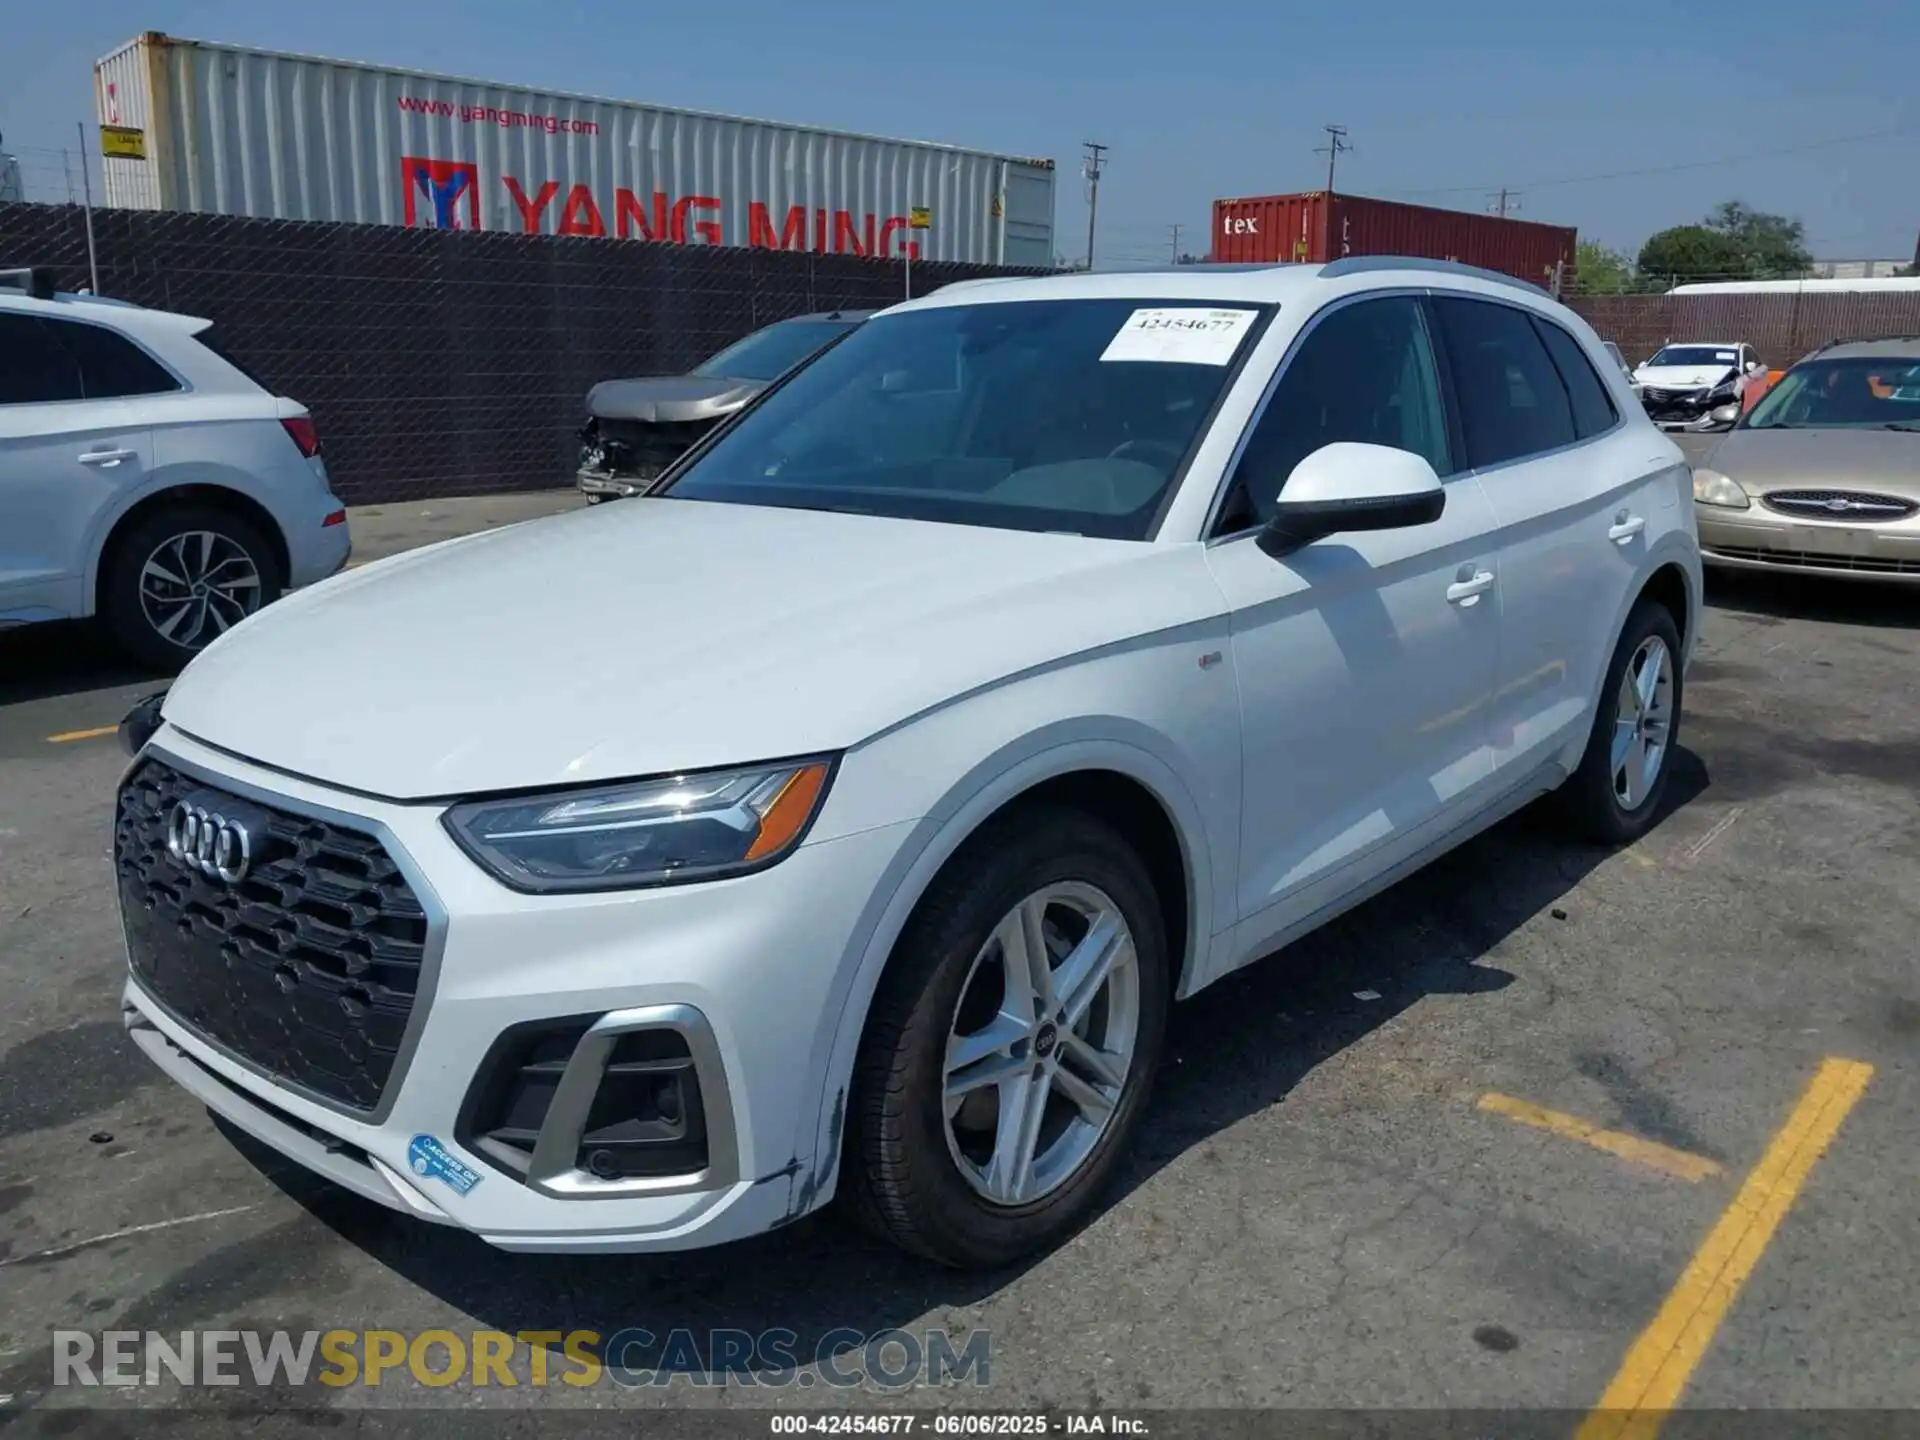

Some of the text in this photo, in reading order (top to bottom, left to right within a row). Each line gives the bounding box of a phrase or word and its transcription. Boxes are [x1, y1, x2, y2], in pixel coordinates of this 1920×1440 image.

[398, 96, 599, 134] www.yangming.com
[502, 176, 919, 261] YANG MING
[1224, 215, 1260, 235] tex
